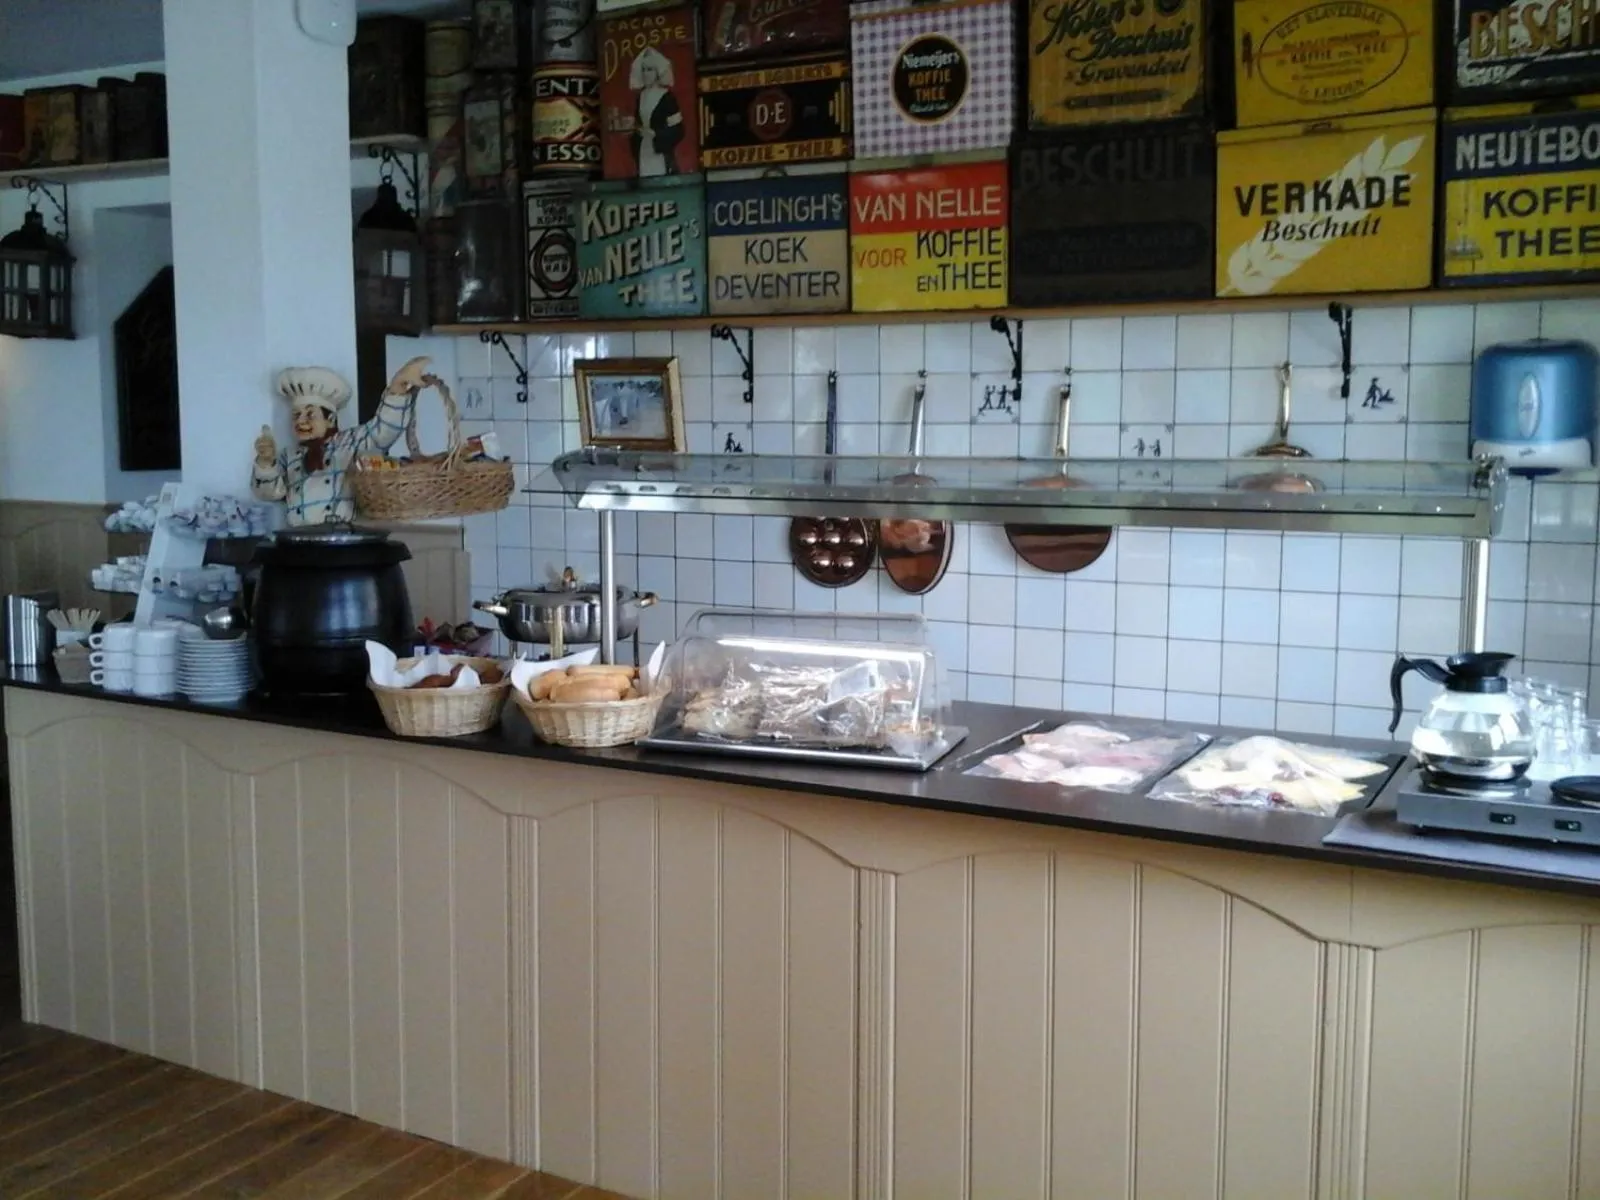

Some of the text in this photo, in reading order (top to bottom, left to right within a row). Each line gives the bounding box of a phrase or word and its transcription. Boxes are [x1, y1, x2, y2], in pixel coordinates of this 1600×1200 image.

[605, 14, 667, 33] CACAO
[603, 25, 688, 83] DROSTE
[1020, 132, 1204, 191] BESCHUIT
[714, 193, 843, 227] COELINGH'S
[853, 184, 1001, 223] VAN NELLE
[1234, 173, 1413, 217] VERKADE
[580, 199, 679, 245] KOFFIE
[1261, 214, 1382, 243] Beschuit
[743, 237, 809, 266] KOEK
[856, 246, 908, 269] VOOR
[916, 226, 1003, 260] KOFFIE
[1495, 224, 1600, 258] THEE
[578, 265, 604, 290] VAN
[618, 267, 697, 308] THEE
[714, 269, 841, 301] DEVENTER
[937, 260, 1003, 292] THEE
